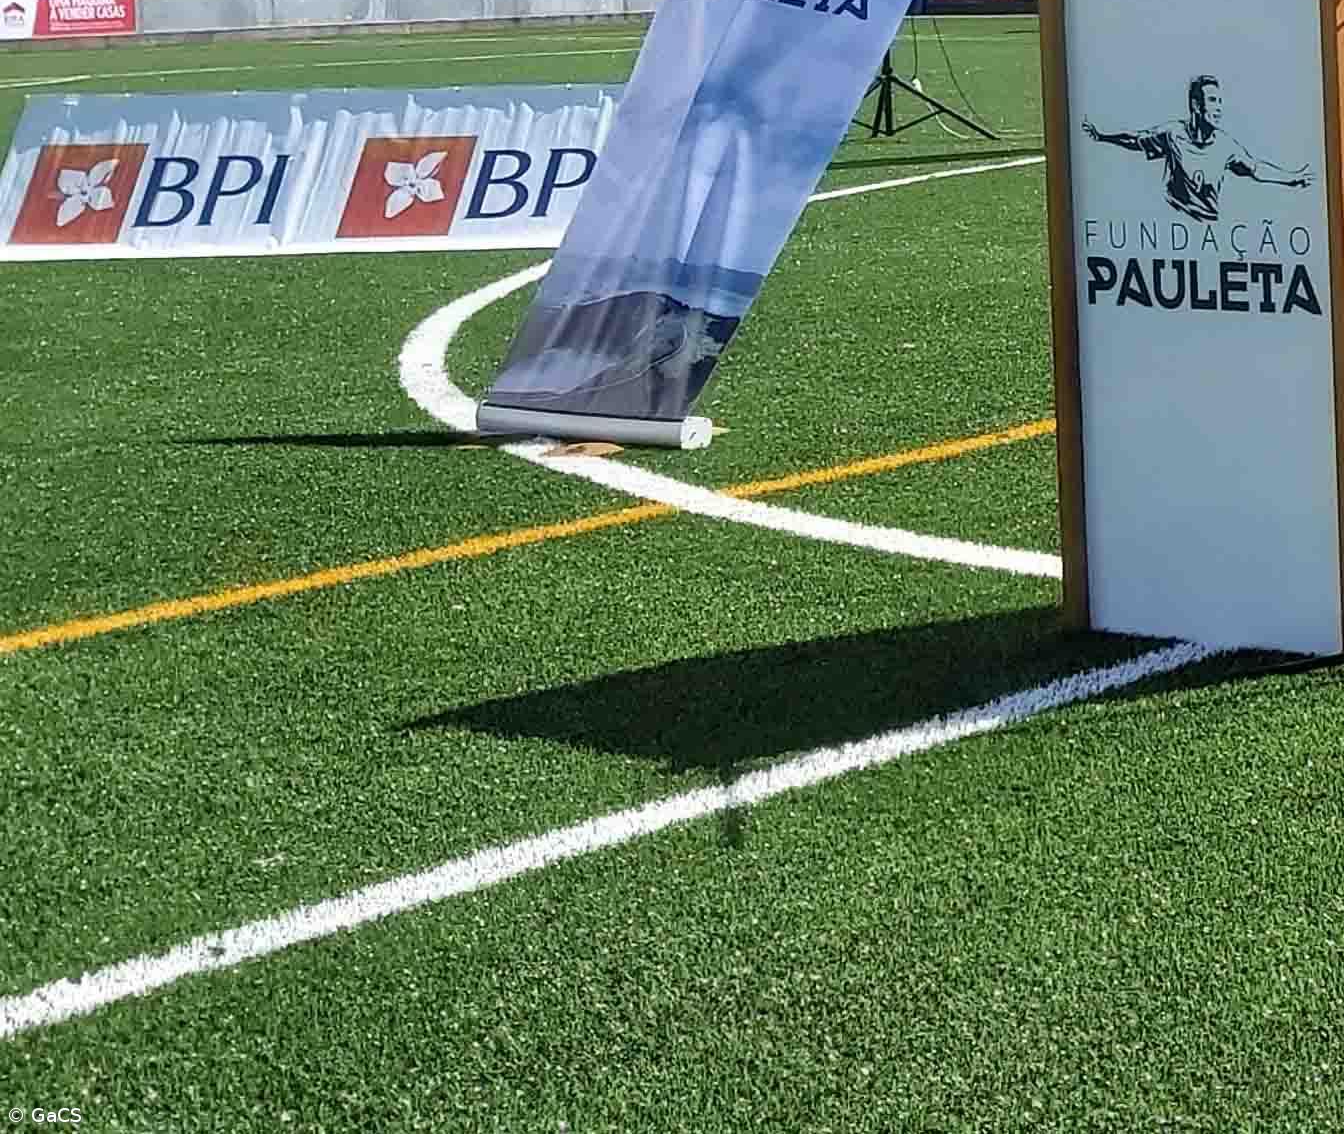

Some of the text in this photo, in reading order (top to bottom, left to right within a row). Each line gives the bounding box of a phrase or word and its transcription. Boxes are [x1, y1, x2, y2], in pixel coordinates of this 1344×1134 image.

[97, 4, 127, 19] CASAS
[131, 148, 598, 228] BPI BP
[1083, 218, 1312, 261] FUNDAÇÃO
[1086, 256, 1323, 316] PAULETA
